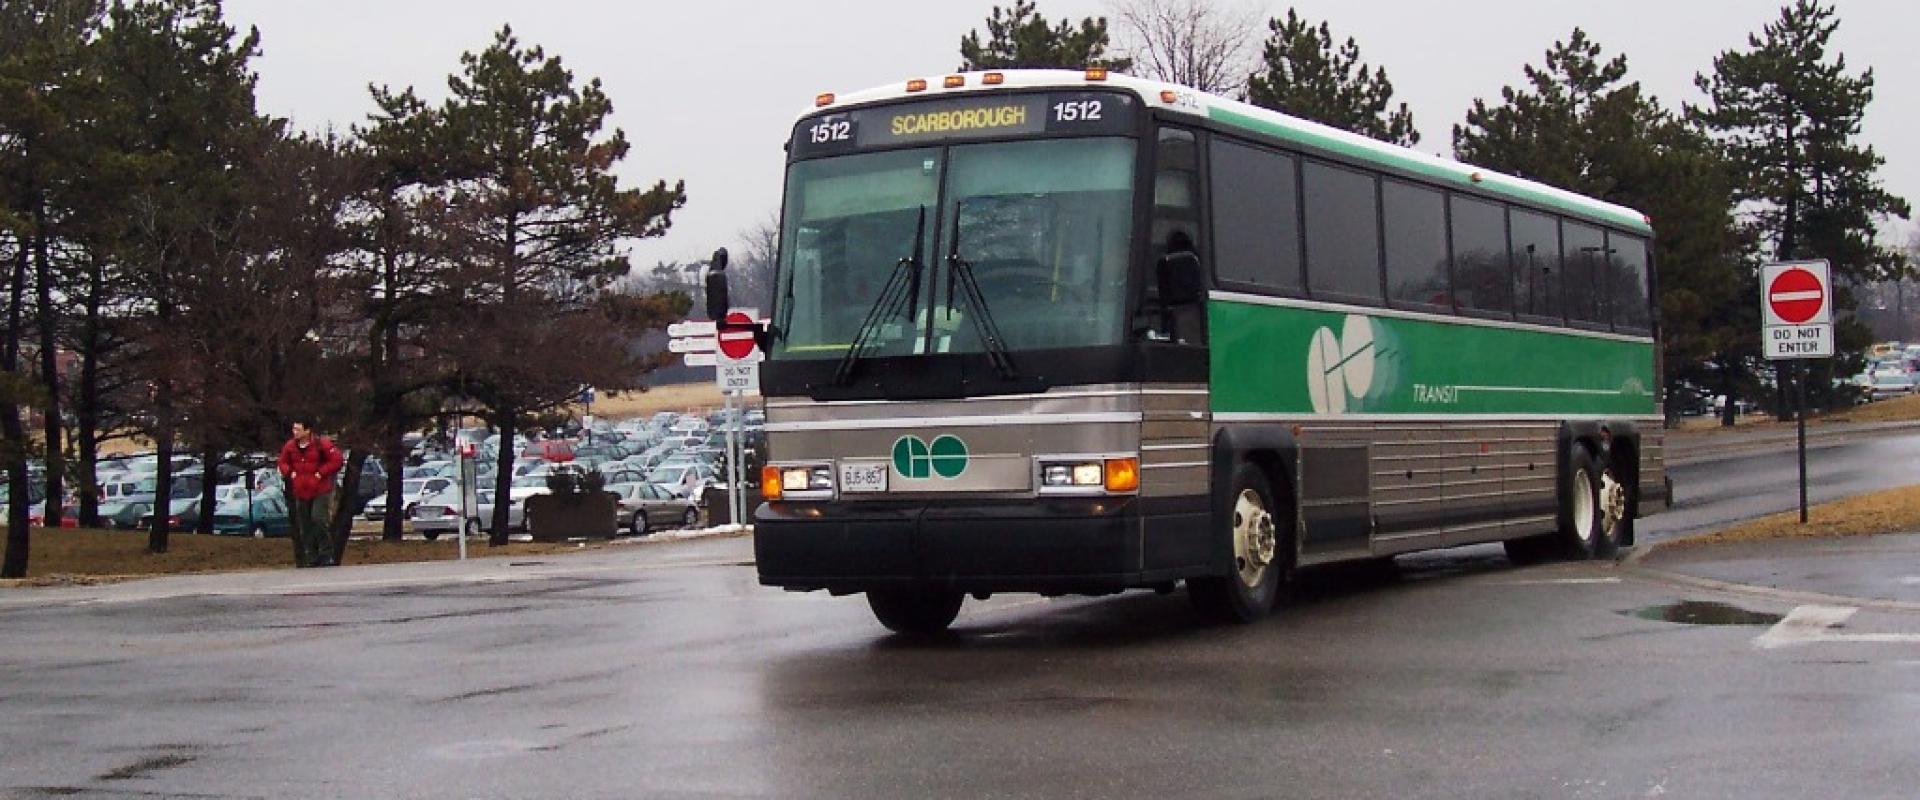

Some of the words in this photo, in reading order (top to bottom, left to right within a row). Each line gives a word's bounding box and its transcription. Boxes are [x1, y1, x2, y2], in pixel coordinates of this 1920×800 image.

[892, 107, 1026, 135] SCARBOROUGH
[1053, 100, 1102, 121] 1512
[809, 121, 850, 143] 1512
[1773, 329, 1791, 340] DO
[1797, 327, 1821, 339] NOT
[1778, 341, 1818, 353] ENTER
[1412, 383, 1458, 404] TRANSIT
